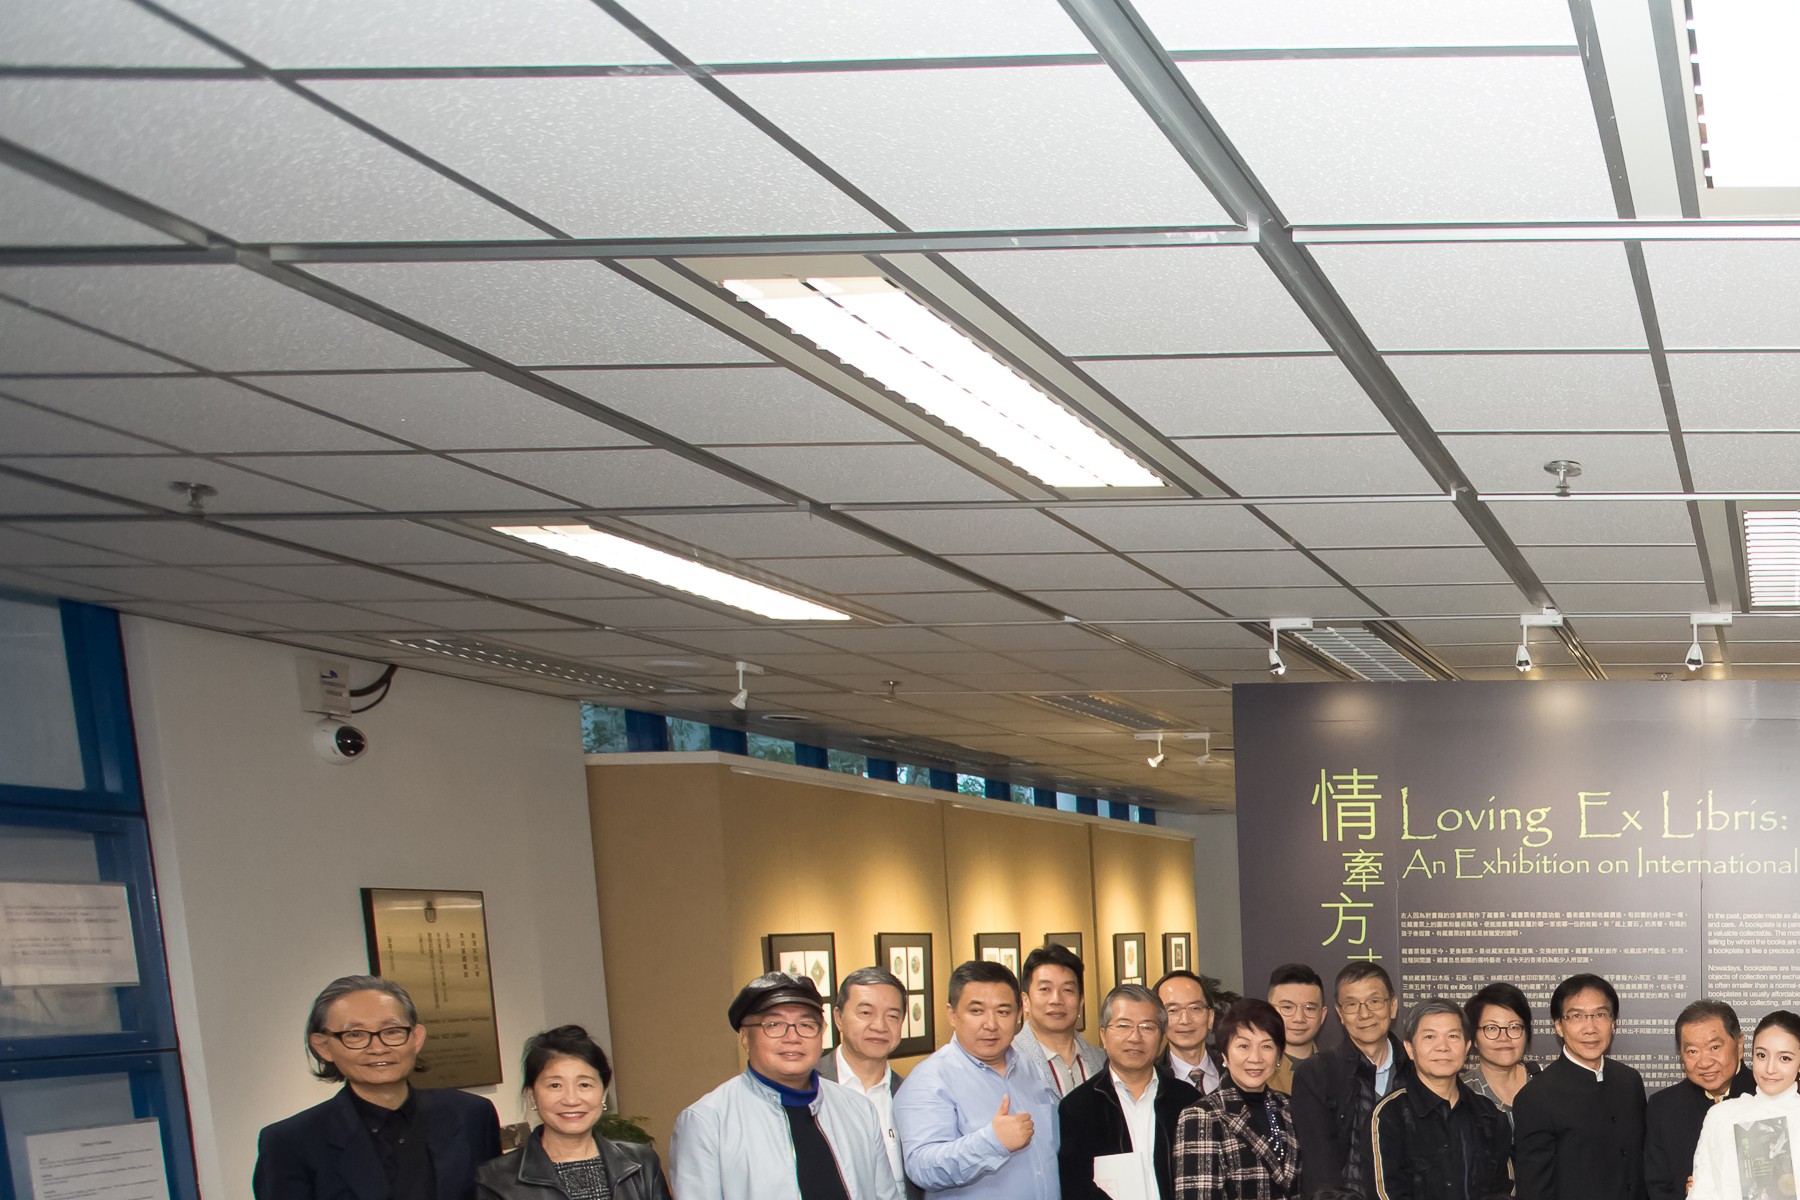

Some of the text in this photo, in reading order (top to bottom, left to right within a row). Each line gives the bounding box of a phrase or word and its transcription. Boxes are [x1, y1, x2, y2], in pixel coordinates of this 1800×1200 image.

[1401, 787, 1788, 847] Loving Ex Libris:
[1402, 848, 1446, 879] An
[1454, 847, 1590, 879] Exhibition
[1598, 858, 1628, 874] on
[1637, 847, 1799, 878] International
[1714, 911, 1725, 919] the
[1742, 911, 1764, 920] people
[1764, 911, 1782, 919] made
[1743, 964, 1777, 973] bookplates
[1708, 990, 1741, 999] bookplates
[1748, 990, 1770, 999] usually
[1733, 998, 1748, 1006] book
